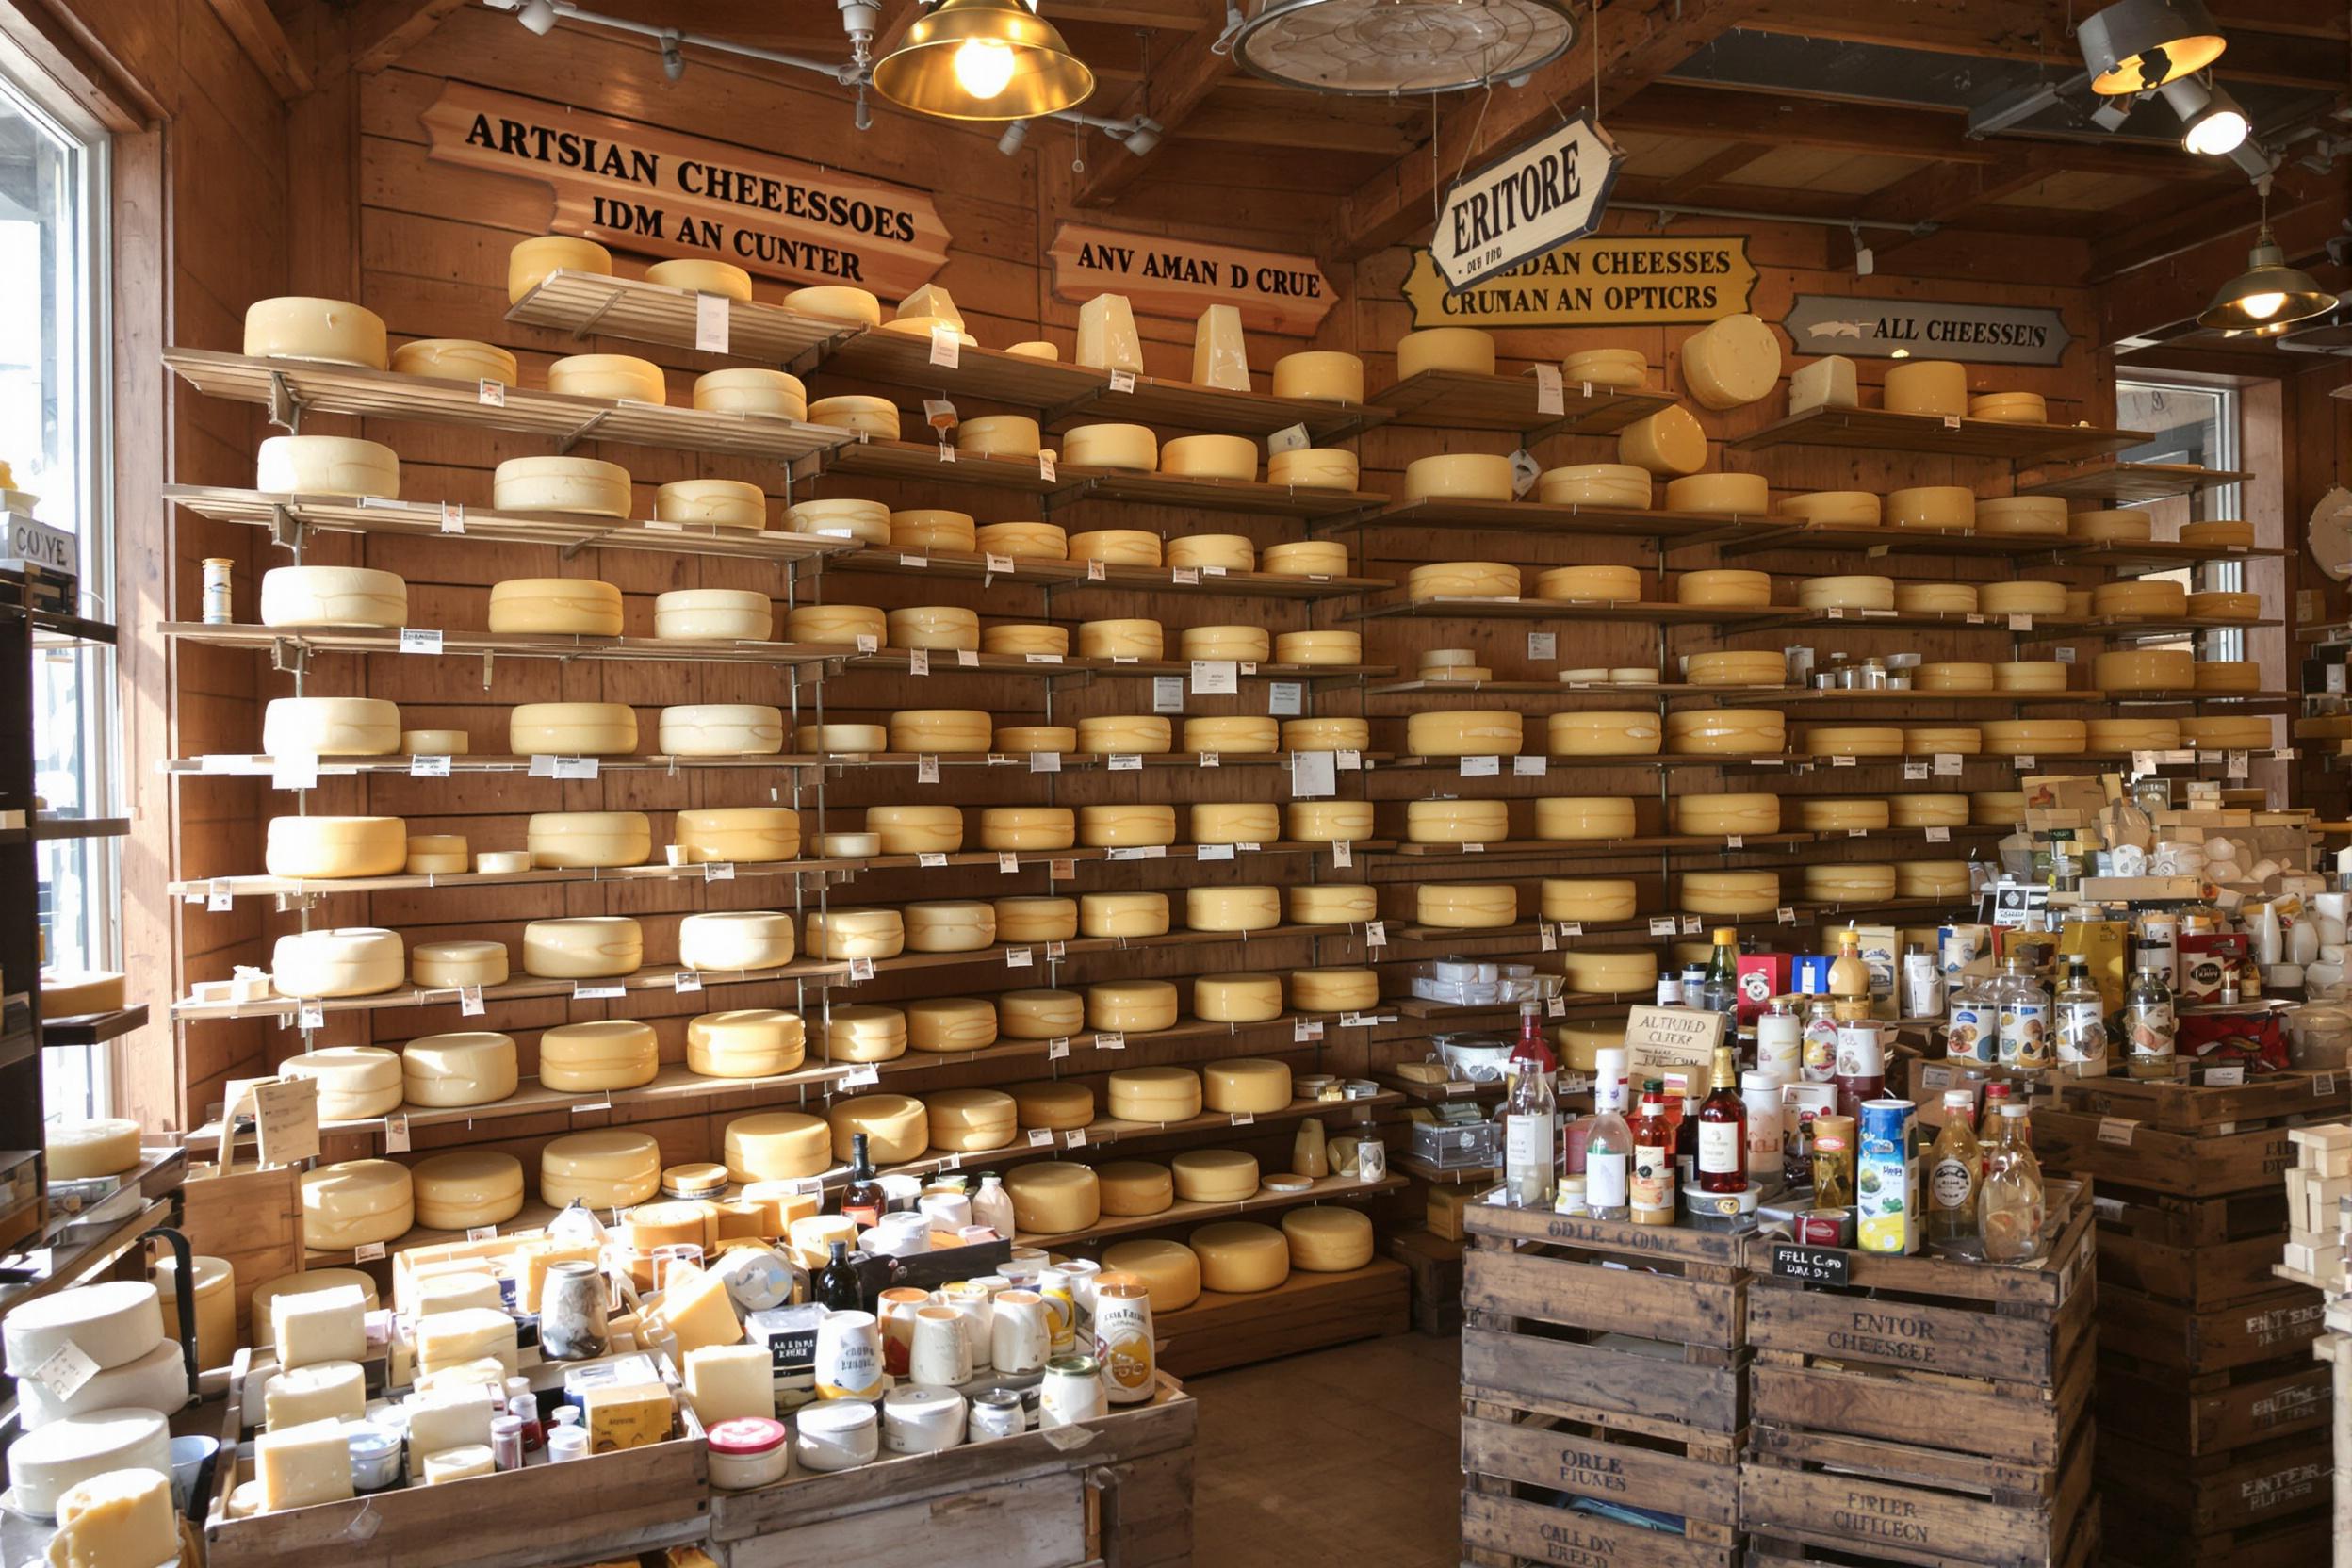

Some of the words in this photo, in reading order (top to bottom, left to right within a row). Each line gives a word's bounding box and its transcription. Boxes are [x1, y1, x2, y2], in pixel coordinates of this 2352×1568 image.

[465, 112, 659, 187] ARTSIAN
[1452, 139, 1582, 259] ERITORE
[592, 196, 665, 239] IDM
[676, 216, 724, 252] AN
[733, 229, 864, 282] CUNTER
[1592, 250, 1731, 275] CHEESSES
[1077, 242, 1135, 273] ANV
[1142, 252, 1218, 286] AMAN
[1230, 264, 1249, 288] D
[1256, 268, 1321, 299] CRUE
[1556, 286, 1593, 312] AN
[1604, 285, 1718, 311] OPTICRS
[1872, 317, 1919, 341] ALL
